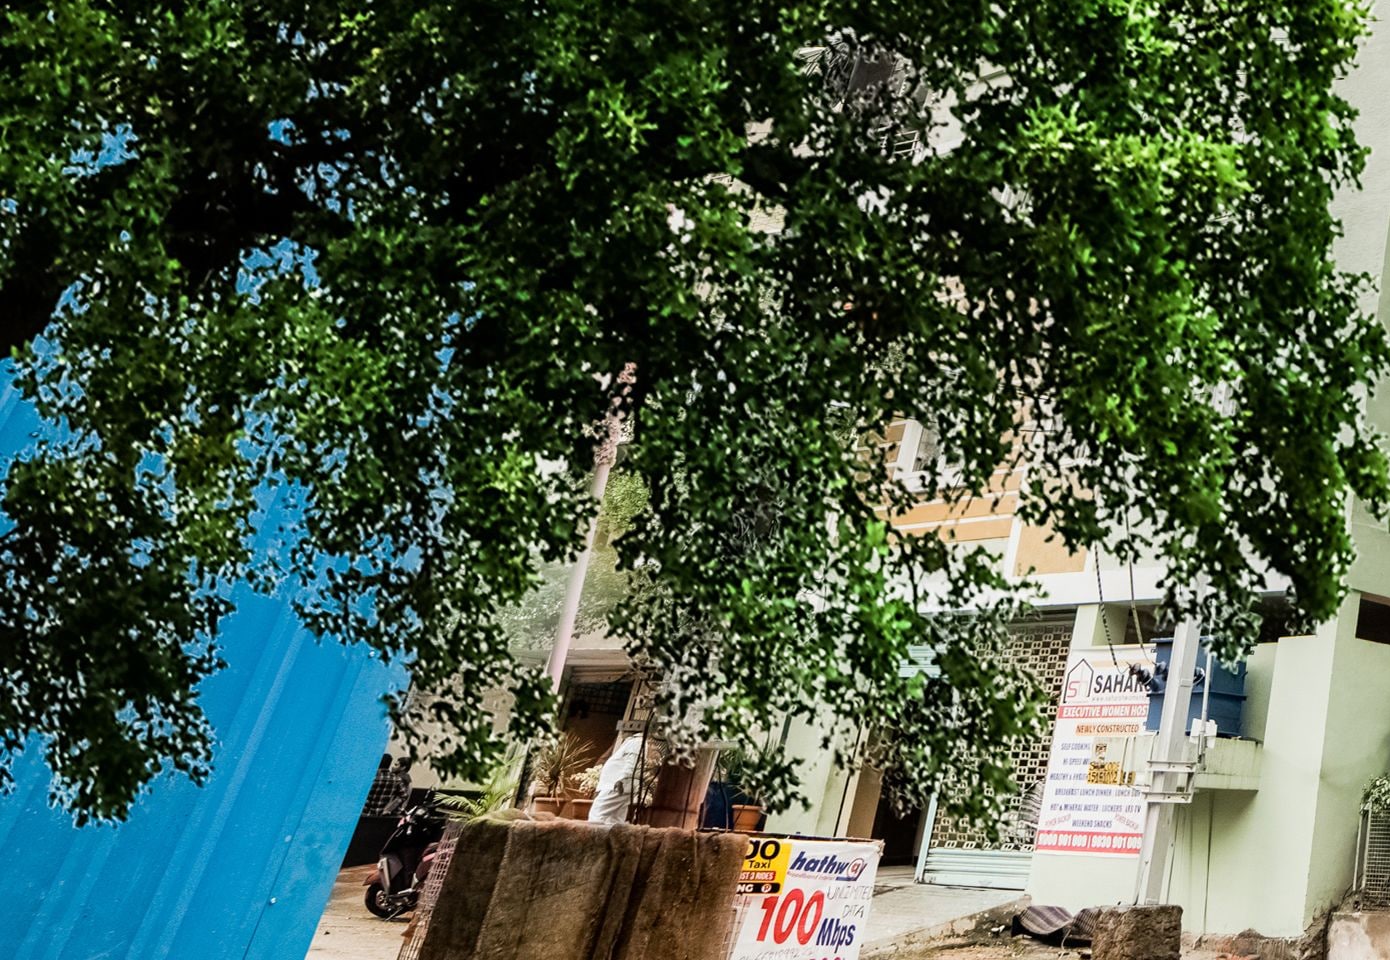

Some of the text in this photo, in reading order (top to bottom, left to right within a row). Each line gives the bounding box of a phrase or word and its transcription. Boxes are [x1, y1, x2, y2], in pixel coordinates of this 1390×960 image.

[1063, 704, 1148, 717] EXECUTIVE WOMEN HOS
[1076, 724, 1140, 733] NEWLY CONSTRUCTED
[749, 859, 771, 869] Taxi
[736, 883, 754, 893] NG
[756, 888, 825, 945] 100
[816, 918, 856, 953] Mbps
